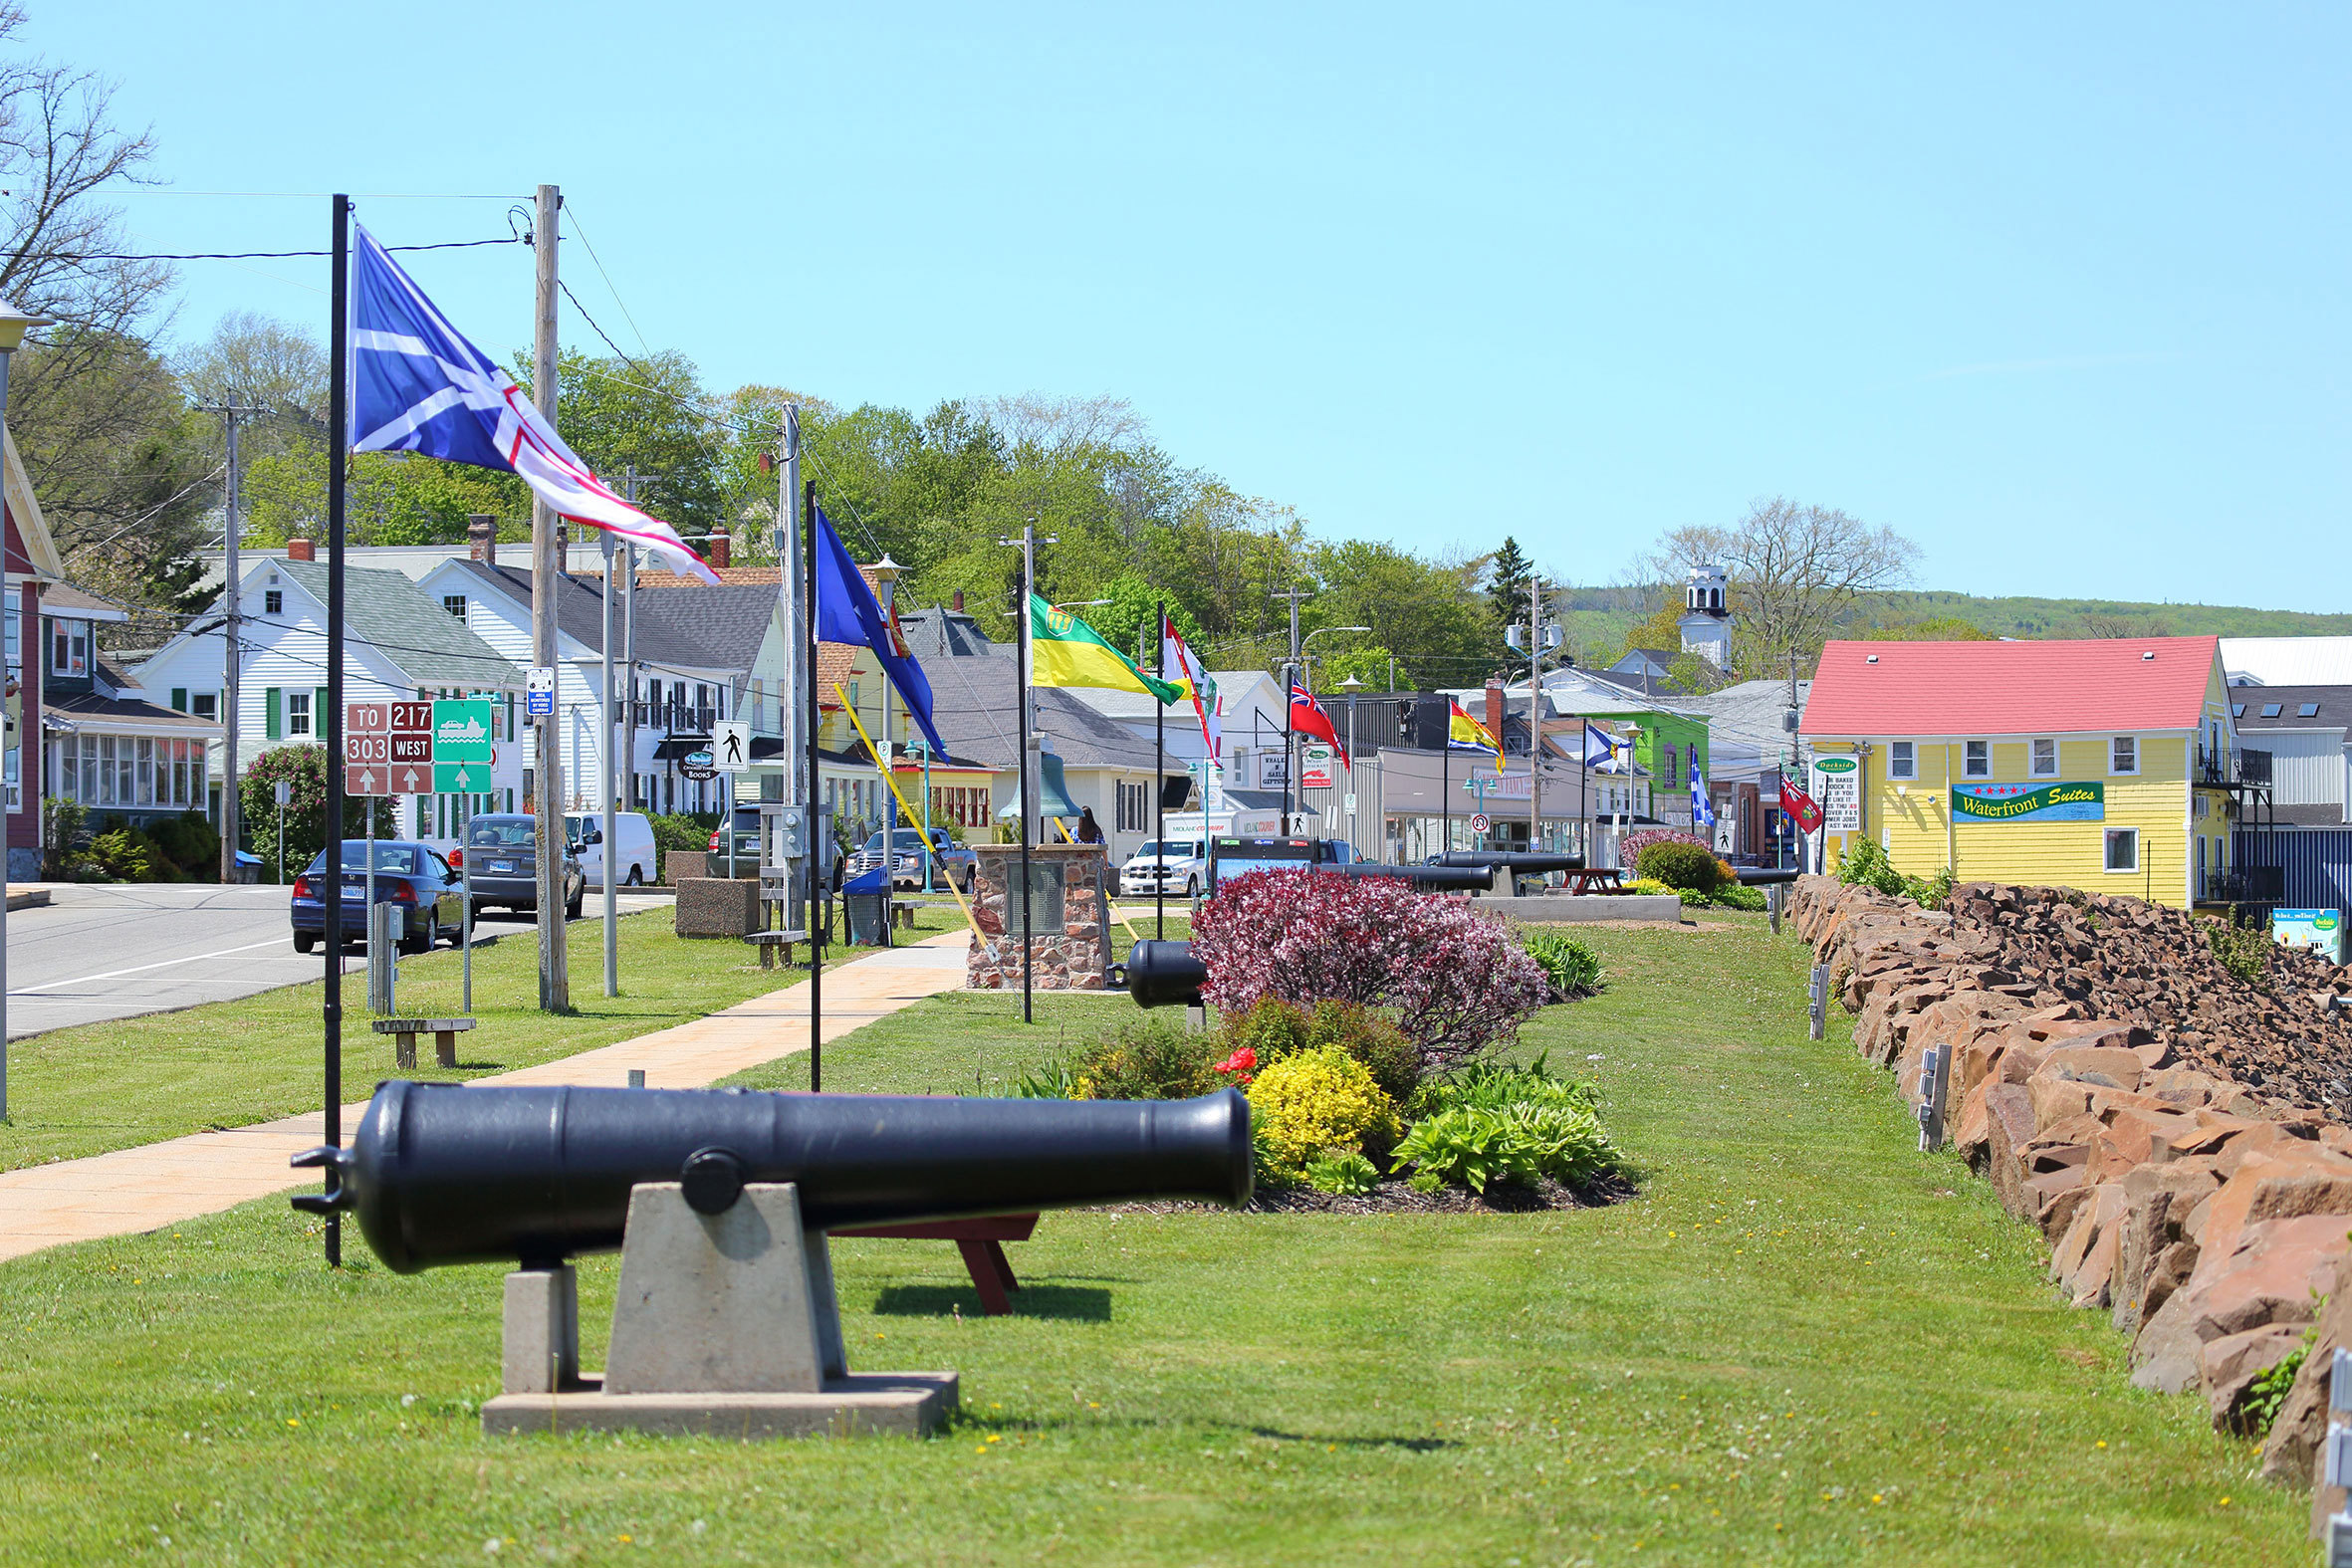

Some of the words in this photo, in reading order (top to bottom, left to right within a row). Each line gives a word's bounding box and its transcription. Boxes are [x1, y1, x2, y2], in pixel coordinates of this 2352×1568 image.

[356, 709, 378, 727] TO
[393, 705, 430, 727] 217
[349, 739, 386, 760] 303
[395, 741, 428, 757] WEST
[1963, 795, 2039, 816] Waterfront
[2048, 787, 2096, 804] Suites
